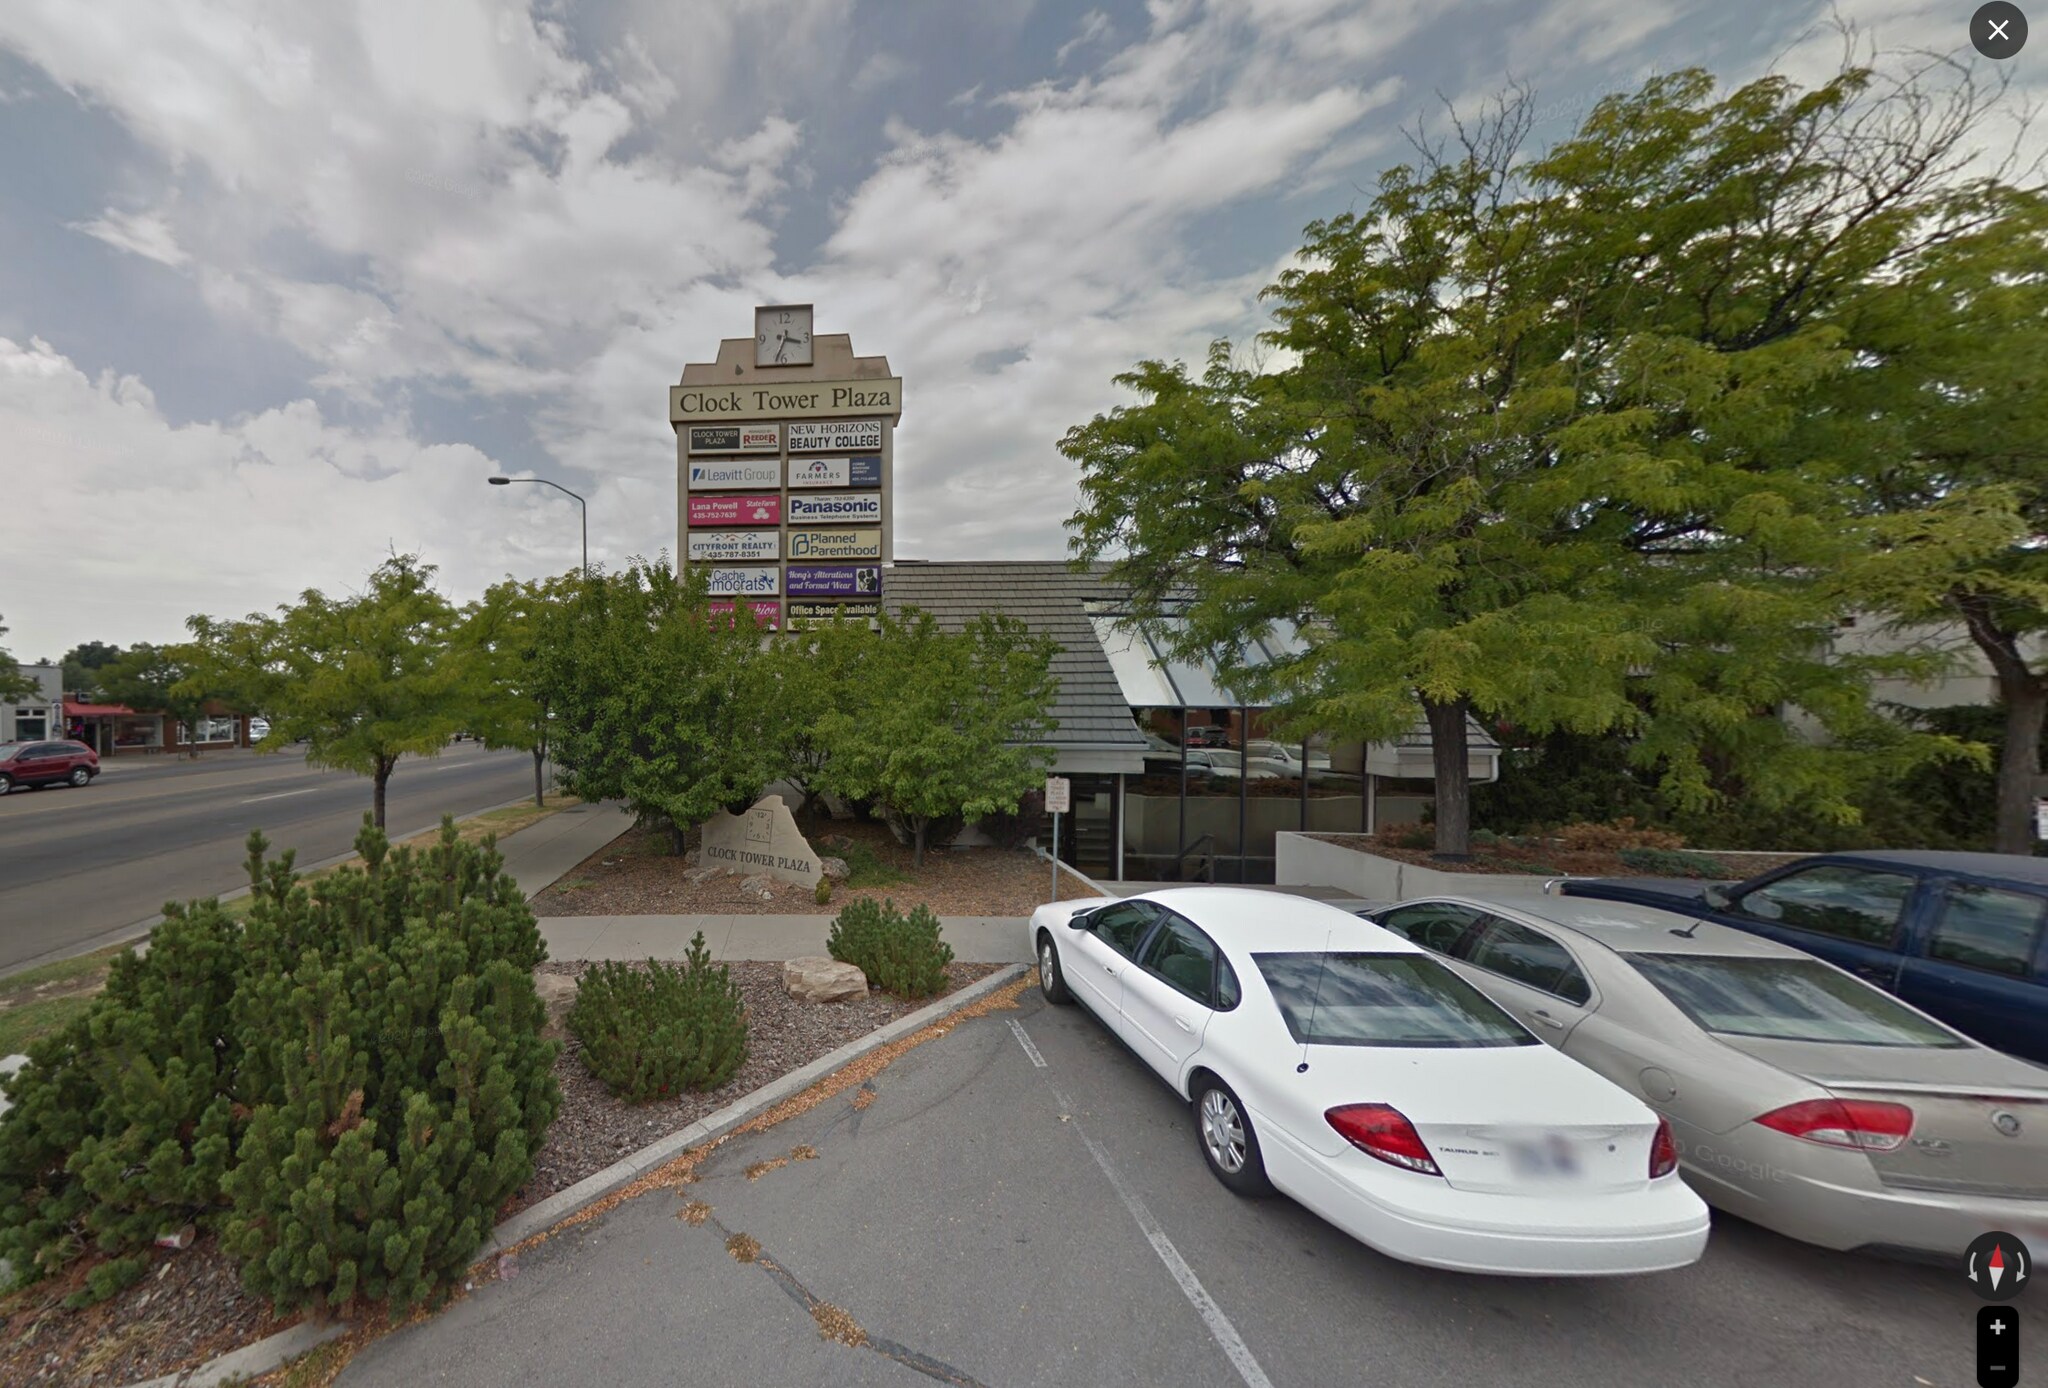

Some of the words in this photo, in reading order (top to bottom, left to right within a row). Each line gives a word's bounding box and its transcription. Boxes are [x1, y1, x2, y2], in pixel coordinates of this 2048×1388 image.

[779, 312, 791, 324] 12
[759, 334, 766, 345] 9
[803, 332, 810, 344] 3
[780, 353, 788, 365] 6
[680, 392, 743, 413] Clock
[753, 391, 819, 410] Tower
[832, 387, 892, 408] Plaza
[790, 425, 816, 435] NEW
[820, 422, 880, 434] HORIZONS
[743, 434, 777, 444] REEDER
[790, 437, 831, 449] BEAUTY
[835, 434, 880, 448] COLLEGE
[796, 472, 841, 480] FARMERS
[692, 503, 711, 511] Lana
[712, 502, 738, 510] Powell
[791, 498, 878, 514] Panasonic
[811, 533, 856, 543] Planned
[741, 542, 773, 550] REALTY
[811, 545, 877, 556] Parenthood
[713, 570, 745, 581] Cache
[788, 571, 811, 580] Hong's
[706, 577, 766, 591] emocrats
[790, 605, 813, 615] Office
[843, 605, 877, 614] vailable
[707, 846, 737, 861] CLOCK
[739, 851, 775, 867] TOWER
[777, 856, 811, 873] PLAZA
[1439, 1146, 1479, 1155] TAURUS
